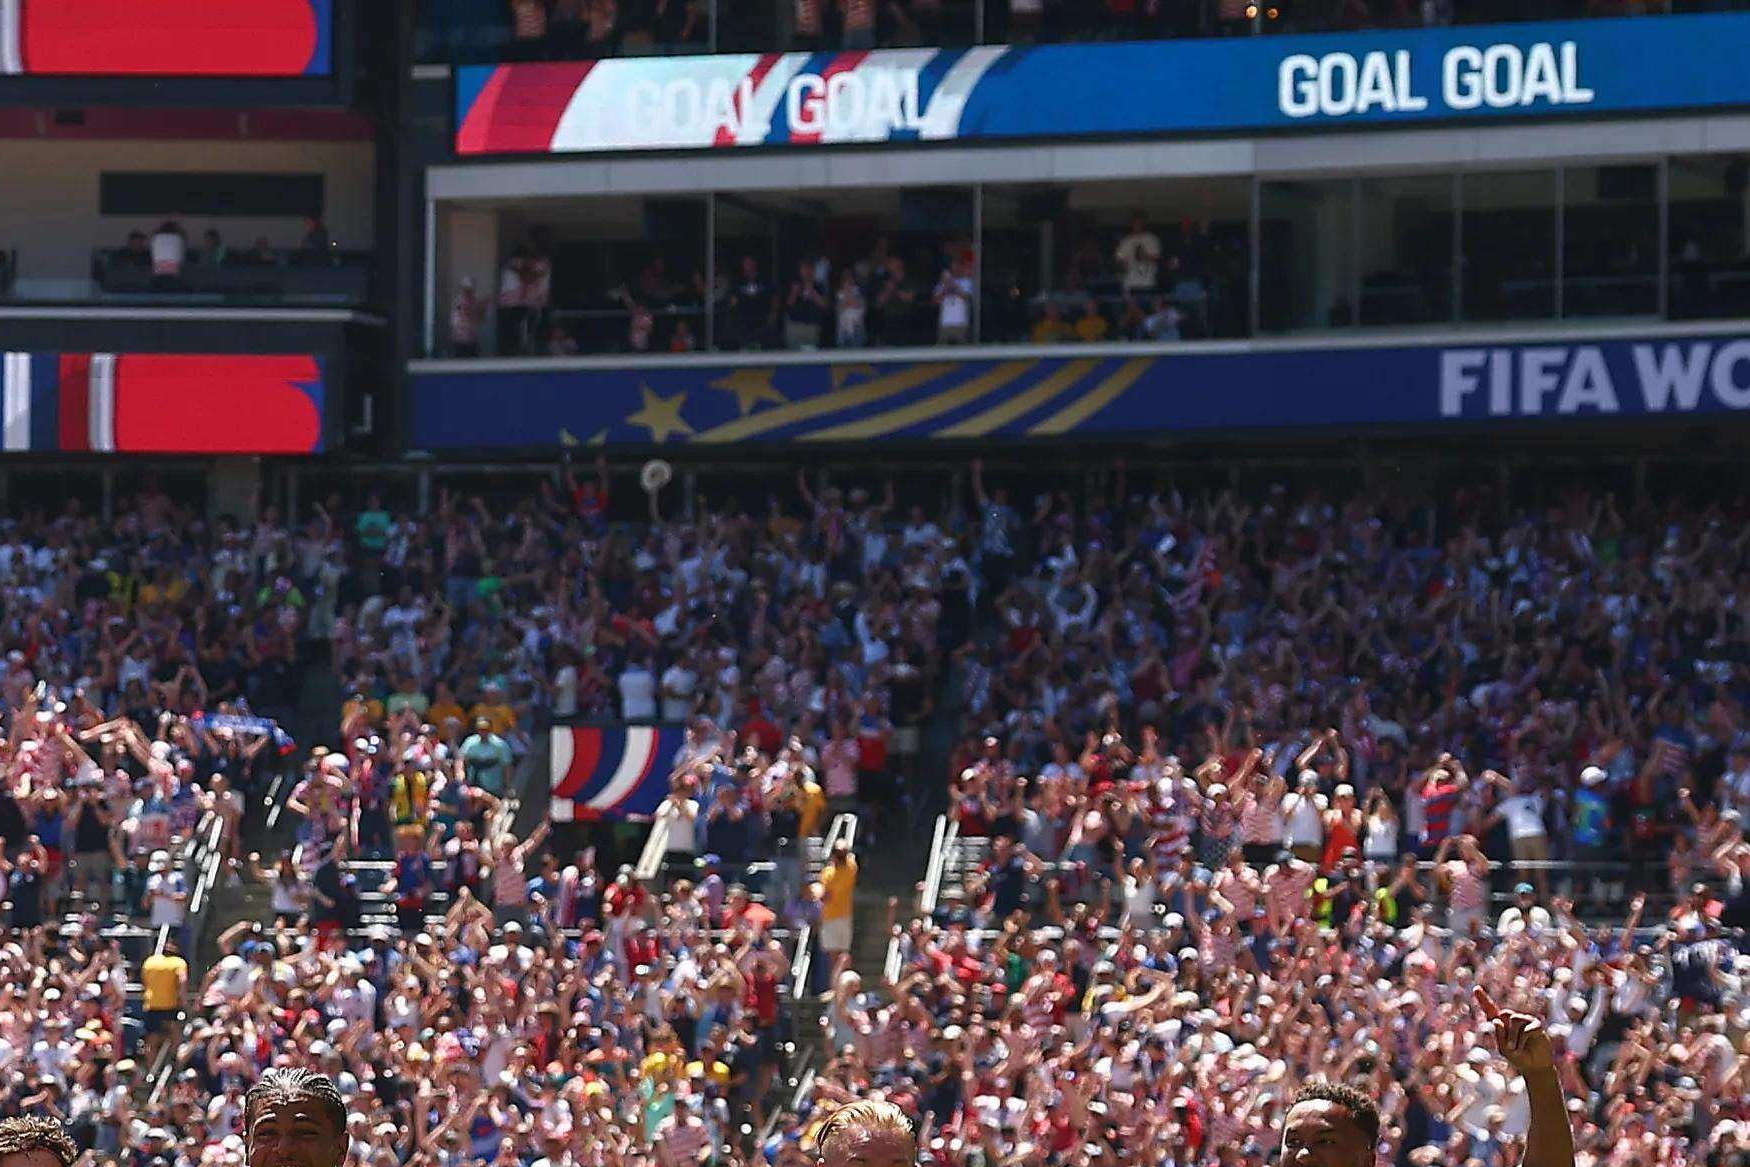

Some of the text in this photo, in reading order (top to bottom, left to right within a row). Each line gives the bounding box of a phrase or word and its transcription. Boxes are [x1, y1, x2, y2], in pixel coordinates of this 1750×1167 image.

[786, 66, 931, 134] GOAL
[1278, 41, 1594, 117] GOAL GOAL
[1439, 346, 1620, 418] FIFA
